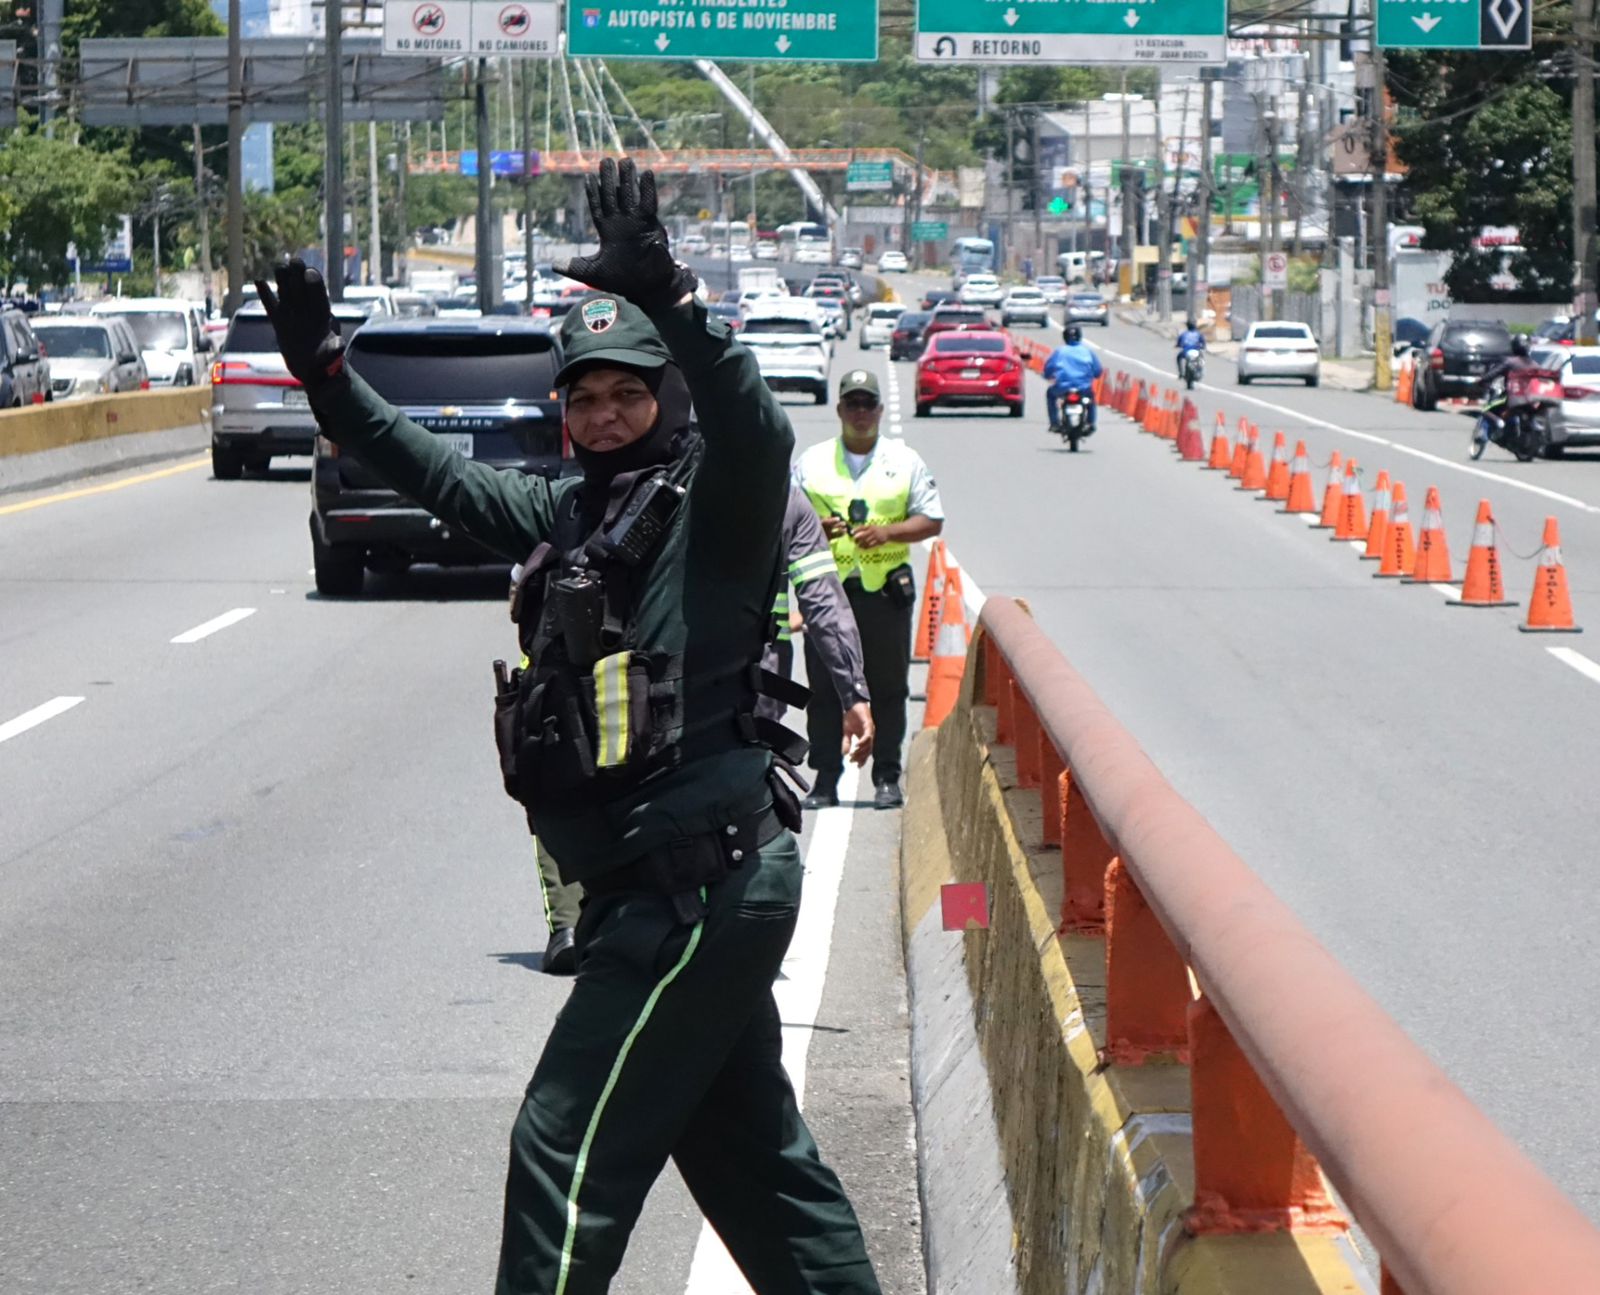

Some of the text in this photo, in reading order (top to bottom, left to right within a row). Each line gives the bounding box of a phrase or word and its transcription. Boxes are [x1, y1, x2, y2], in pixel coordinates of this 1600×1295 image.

[607, 9, 837, 30] AUTOPISTA 6 DE NOVIEMBRE
[397, 39, 462, 50] NO MOTORES
[479, 40, 548, 51] NO CAMIONES
[972, 39, 1042, 56] RETORNO
